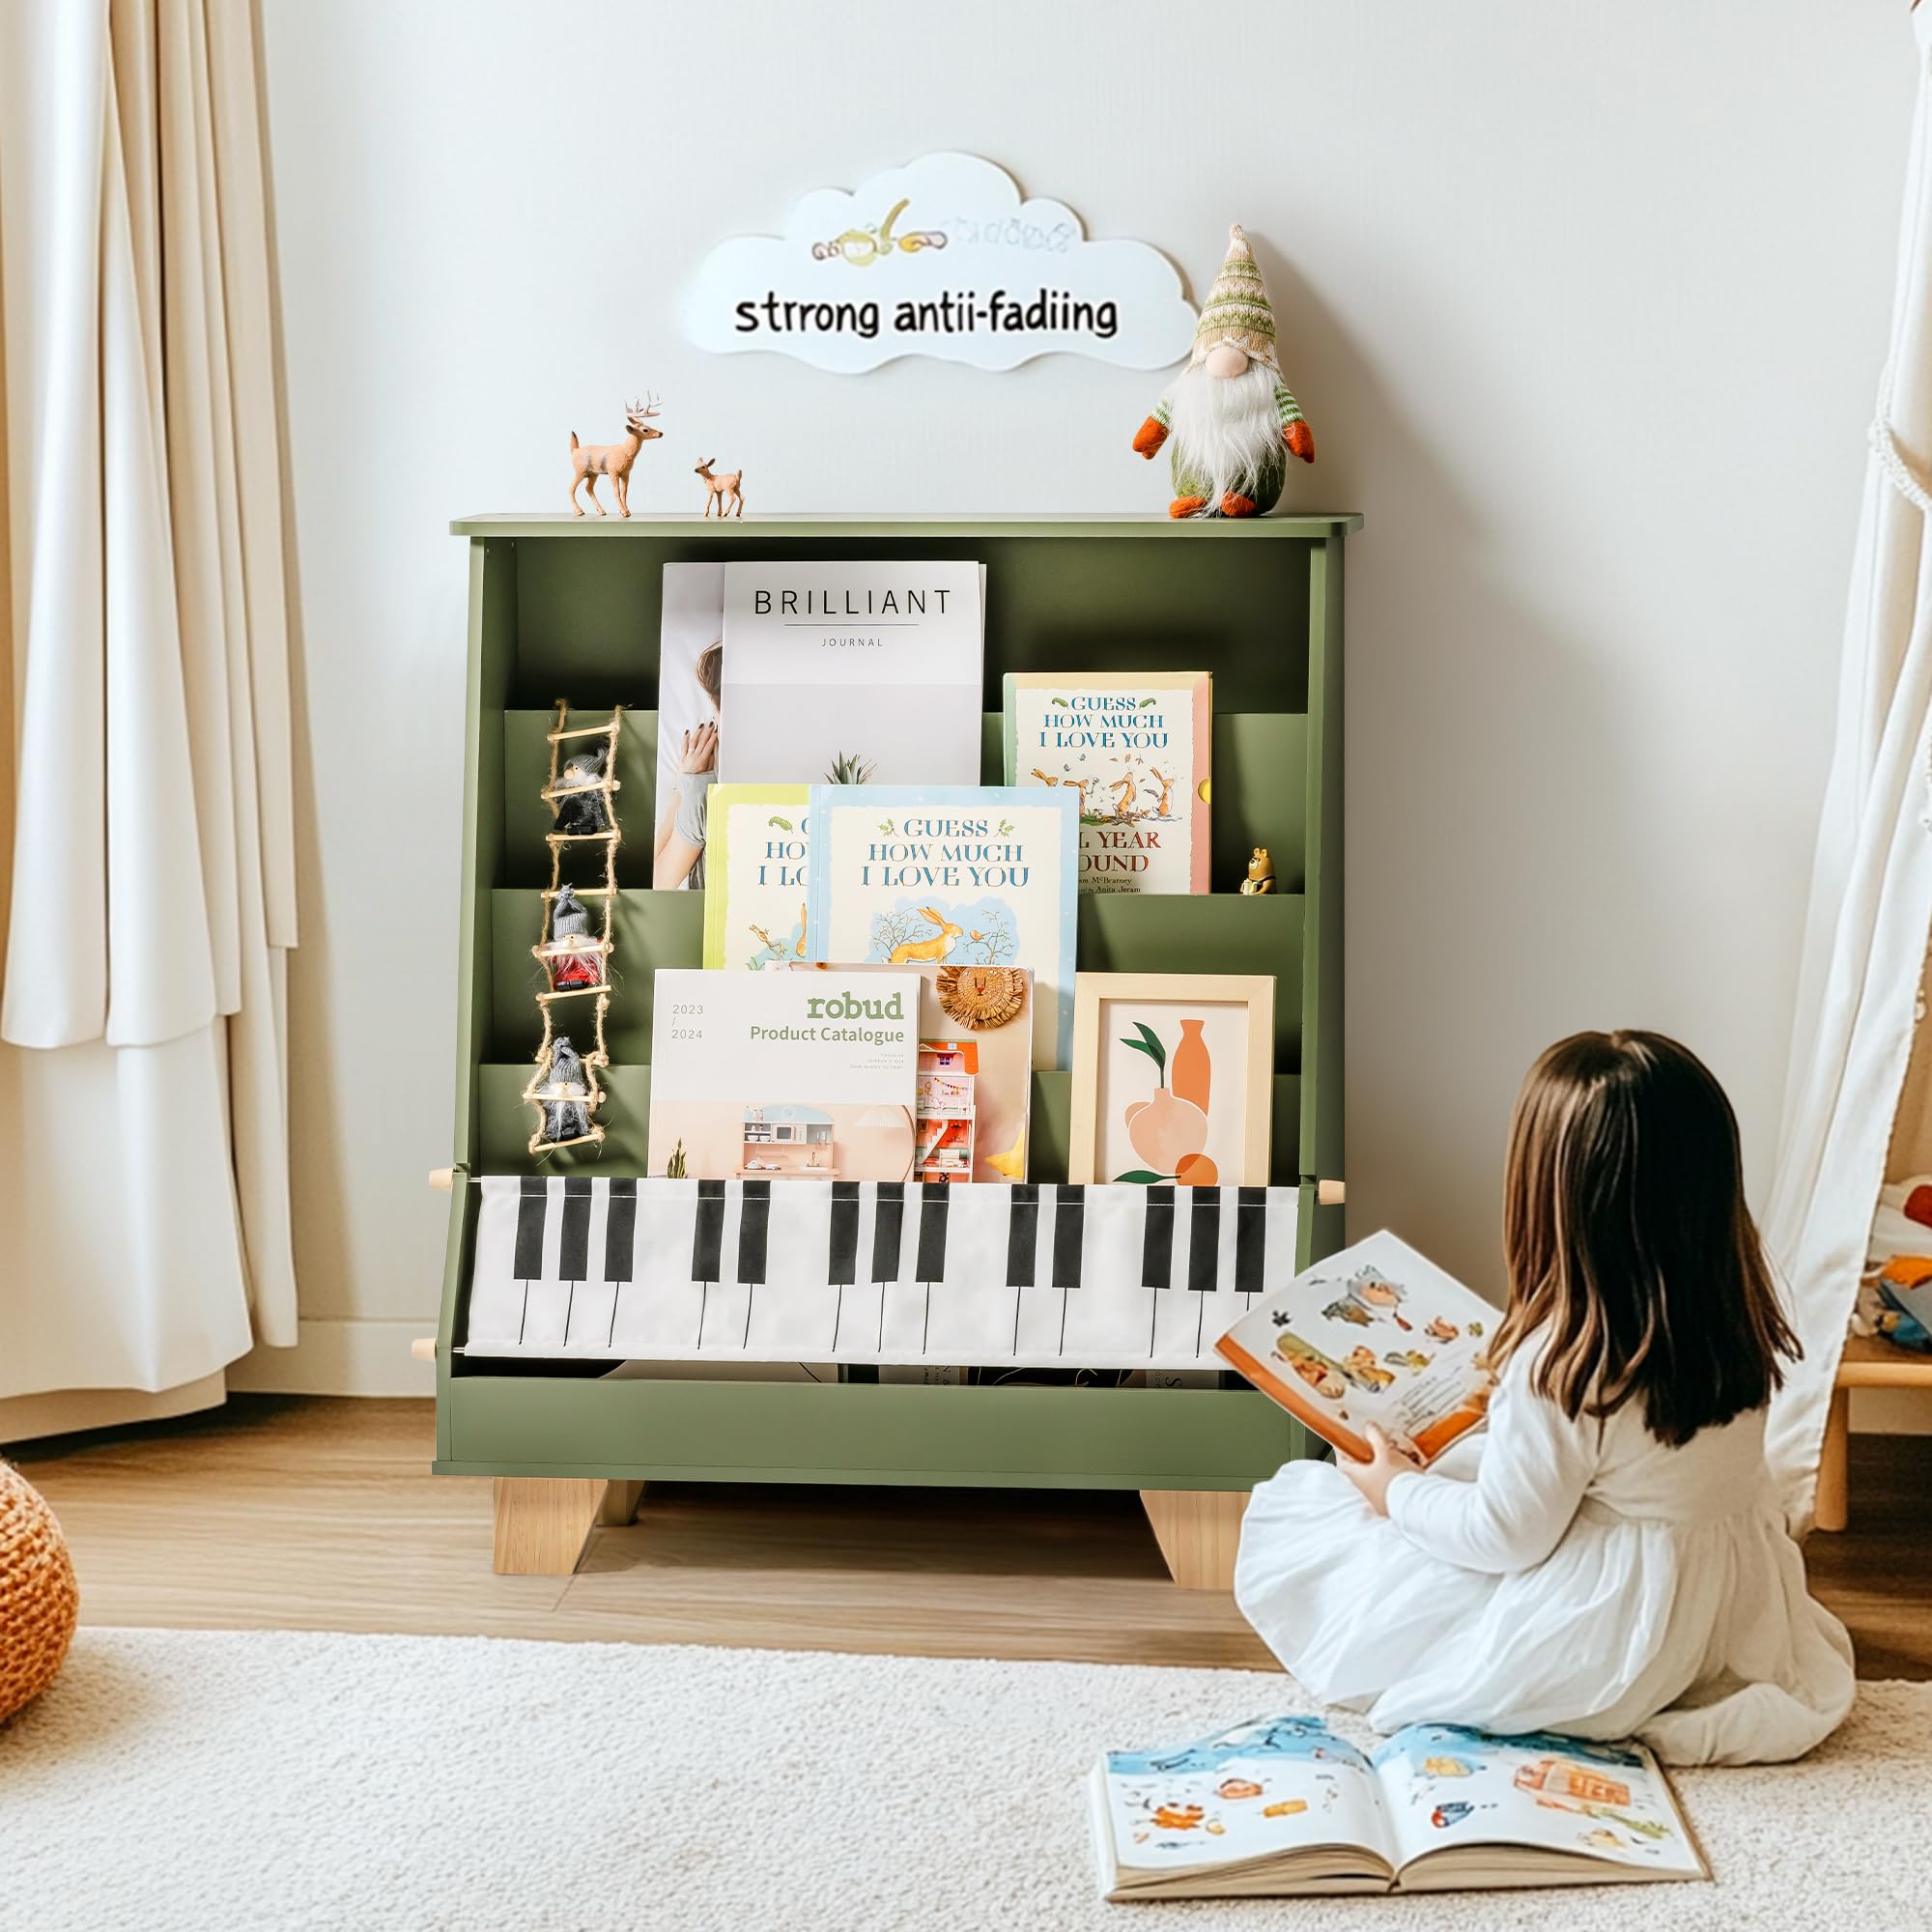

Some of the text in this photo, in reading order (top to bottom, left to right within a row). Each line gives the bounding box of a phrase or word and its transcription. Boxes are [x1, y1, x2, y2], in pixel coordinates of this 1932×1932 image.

[735, 288, 1119, 339] strrong antii-fadiing
[753, 589, 952, 615] BRILLIANT
[821, 638, 884, 648] JOURNAL
[1069, 696, 1138, 712] GUESS
[1043, 714, 1164, 729] HOW MUCH
[1039, 731, 1169, 749] I LOVE YOU
[903, 818, 989, 838] GUESS
[1095, 831, 1162, 849] YEAR
[764, 841, 810, 860] HO
[867, 842, 1024, 863] HOW MUCH
[1078, 854, 1149, 872] OUND
[758, 866, 809, 887] I LO
[861, 866, 1032, 888] I LOVE YOU
[1095, 885, 1116, 894] Anita
[1118, 885, 1141, 894] Jeram
[672, 1004, 704, 1015] 2023
[807, 991, 906, 1020] robud
[671, 1029, 703, 1040] 2024
[750, 1025, 905, 1046] Product Catalogue
